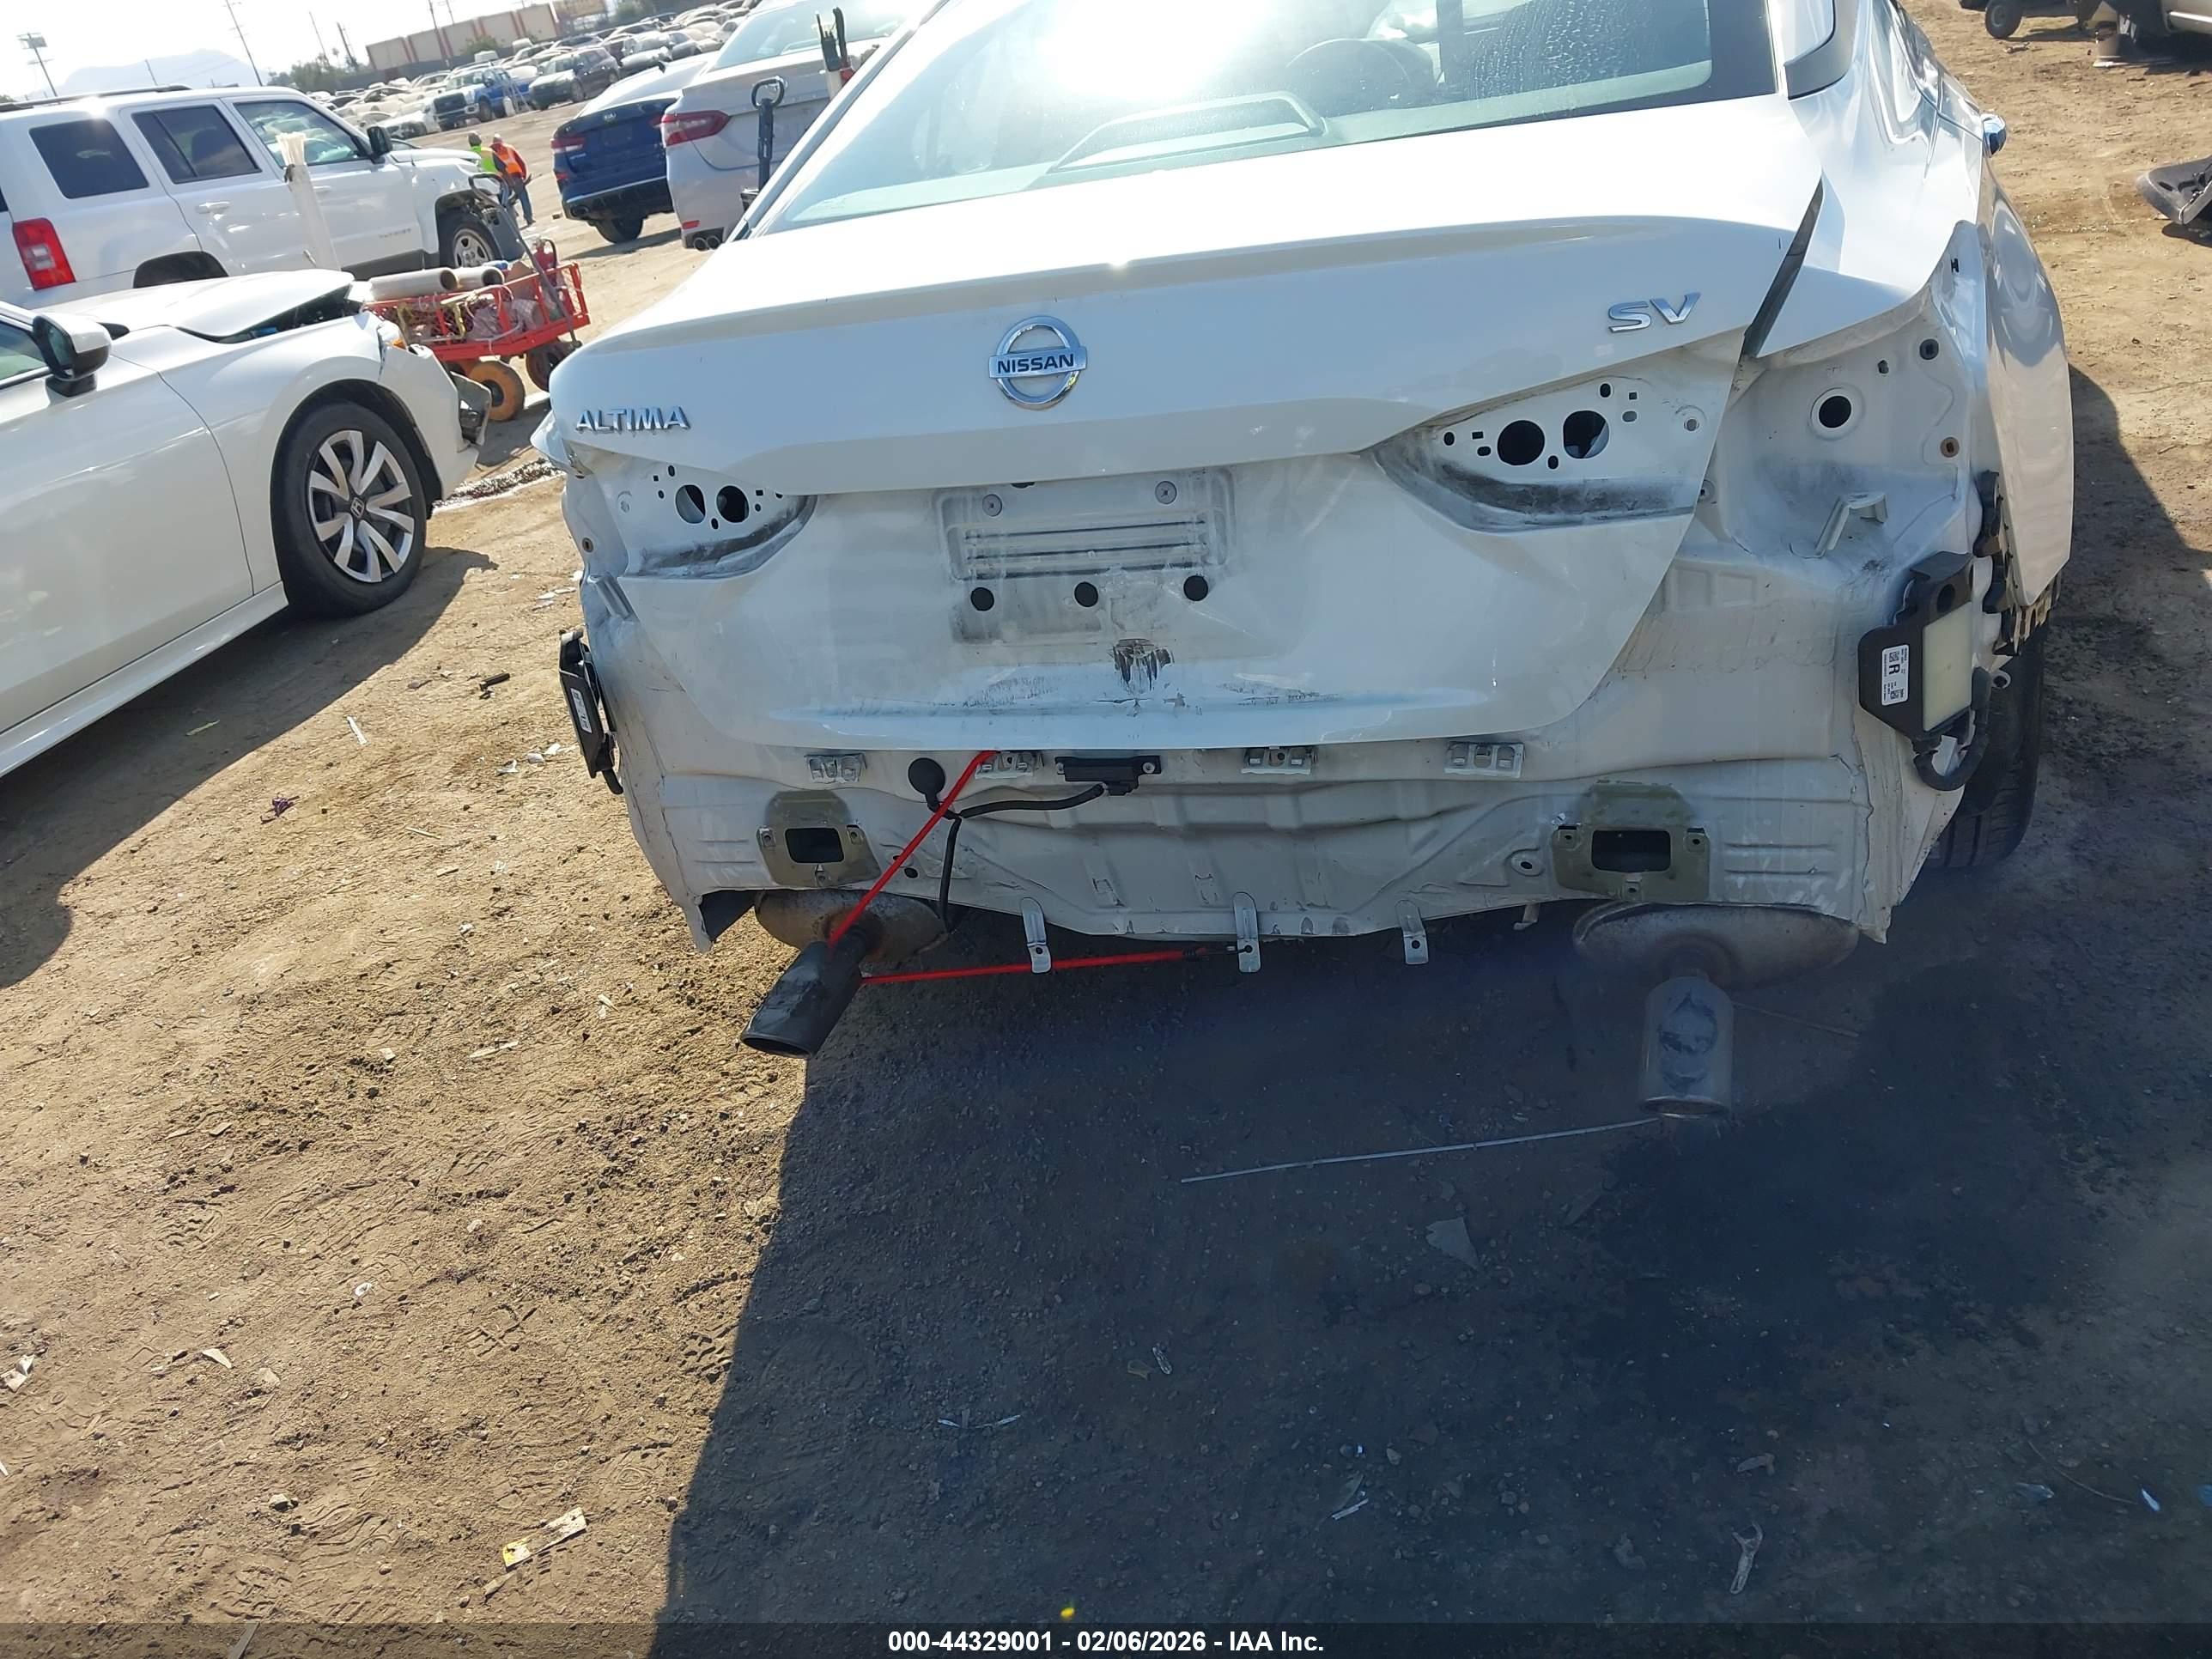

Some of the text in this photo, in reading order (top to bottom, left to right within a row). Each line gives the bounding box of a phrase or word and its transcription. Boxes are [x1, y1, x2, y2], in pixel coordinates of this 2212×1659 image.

[1607, 292, 1701, 333] SV
[997, 353, 1074, 374] NISSAN
[575, 406, 691, 433] ALTIMA
[1888, 664, 1900, 675] R
